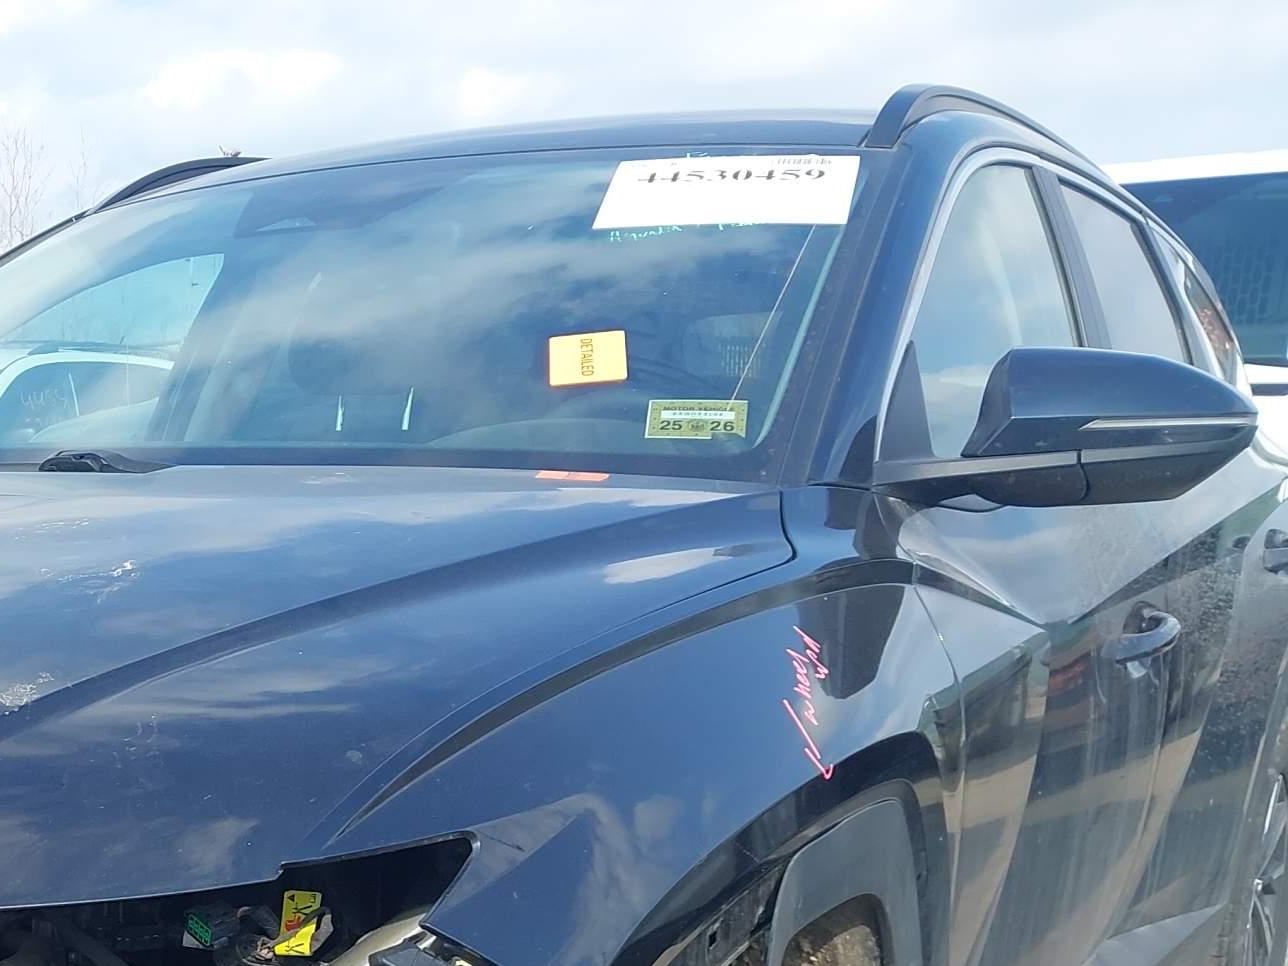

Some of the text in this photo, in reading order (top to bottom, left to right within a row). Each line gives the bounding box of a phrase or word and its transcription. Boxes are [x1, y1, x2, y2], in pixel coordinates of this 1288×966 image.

[638, 168, 826, 183] 44530459
[580, 338, 594, 377] DETAILED
[660, 420, 734, 432] 25 26
